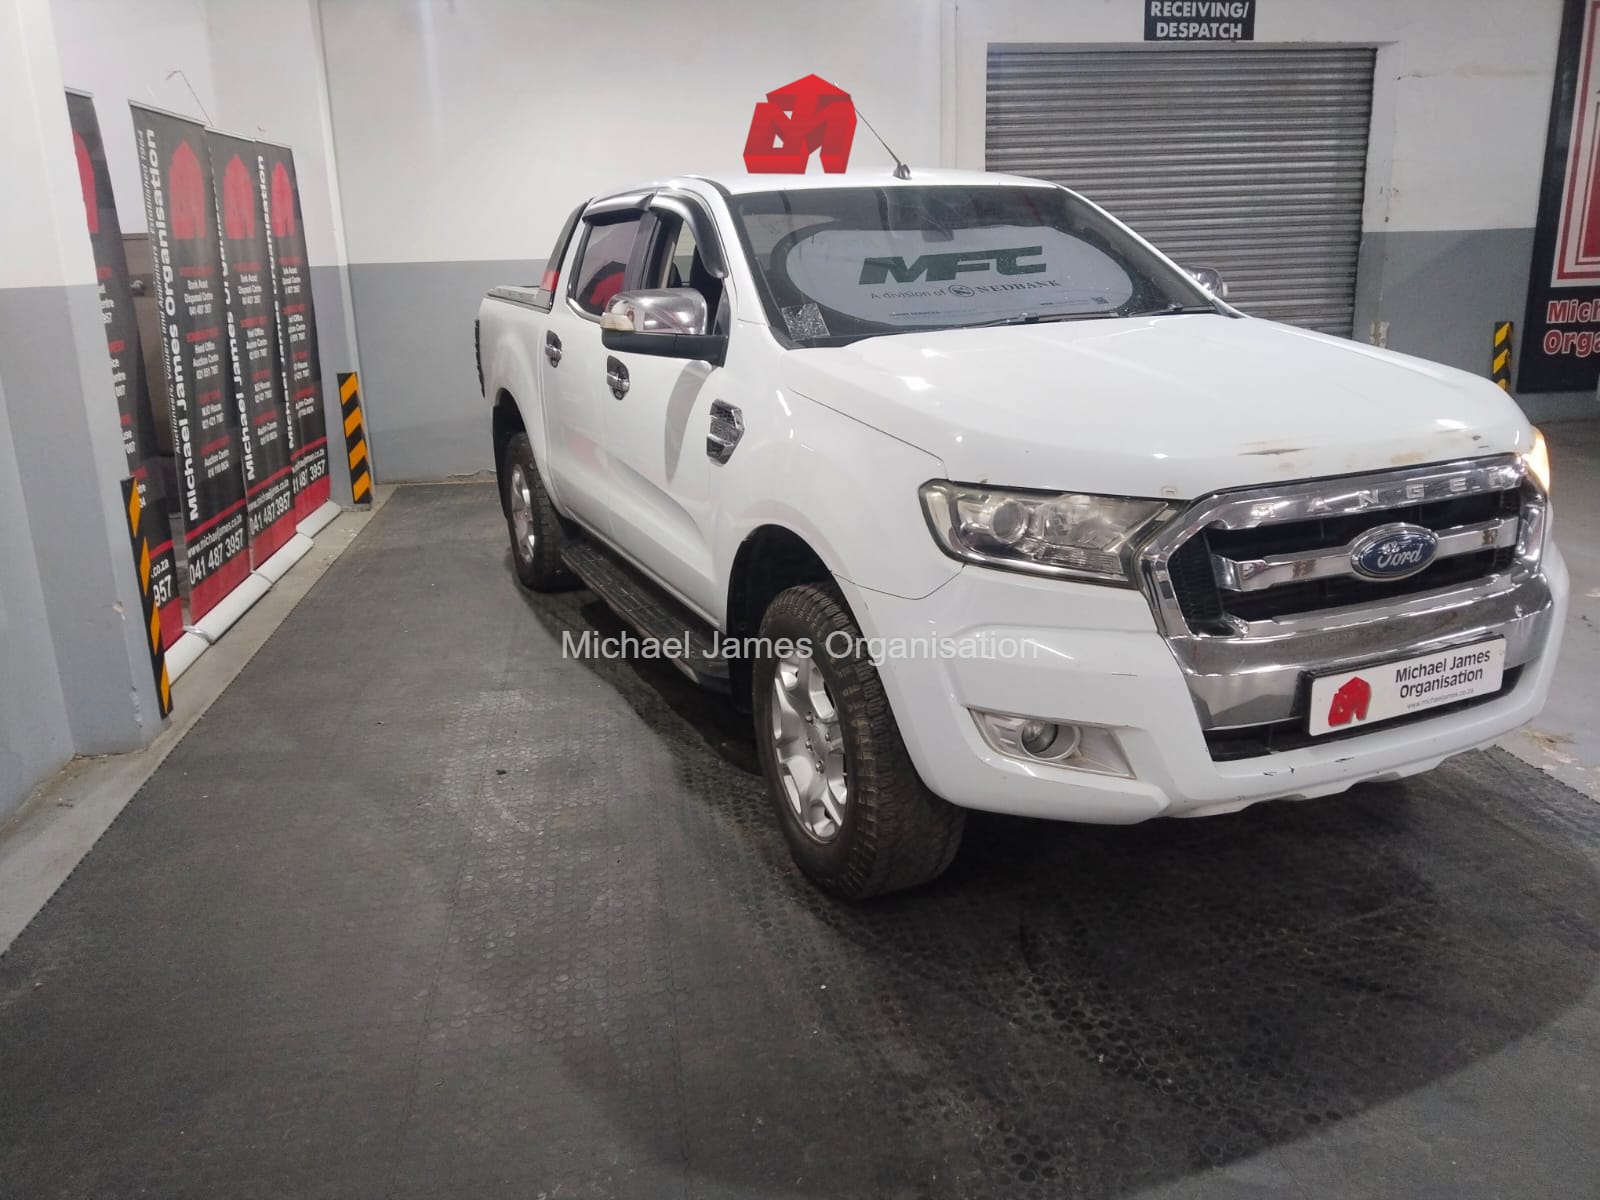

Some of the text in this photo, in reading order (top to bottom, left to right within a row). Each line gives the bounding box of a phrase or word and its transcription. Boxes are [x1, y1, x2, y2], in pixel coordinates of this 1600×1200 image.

[1150, 1, 1250, 18] RECEIVING/
[1156, 22, 1242, 38] DESPATCH
[859, 246, 1047, 285] MFC
[935, 288, 946, 297] of
[976, 279, 1062, 294] NEDBANK
[146, 129, 199, 520] Michael James Organisation
[236, 393, 255, 480] Michael
[309, 460, 326, 481] 3957
[1250, 465, 1509, 518] RANGER
[249, 491, 291, 536] 041 487 3957
[189, 528, 244, 585] 041 487 3957
[1376, 541, 1423, 569] Ford
[1395, 650, 1490, 683] Michael James
[1400, 668, 1483, 698] Organisation
